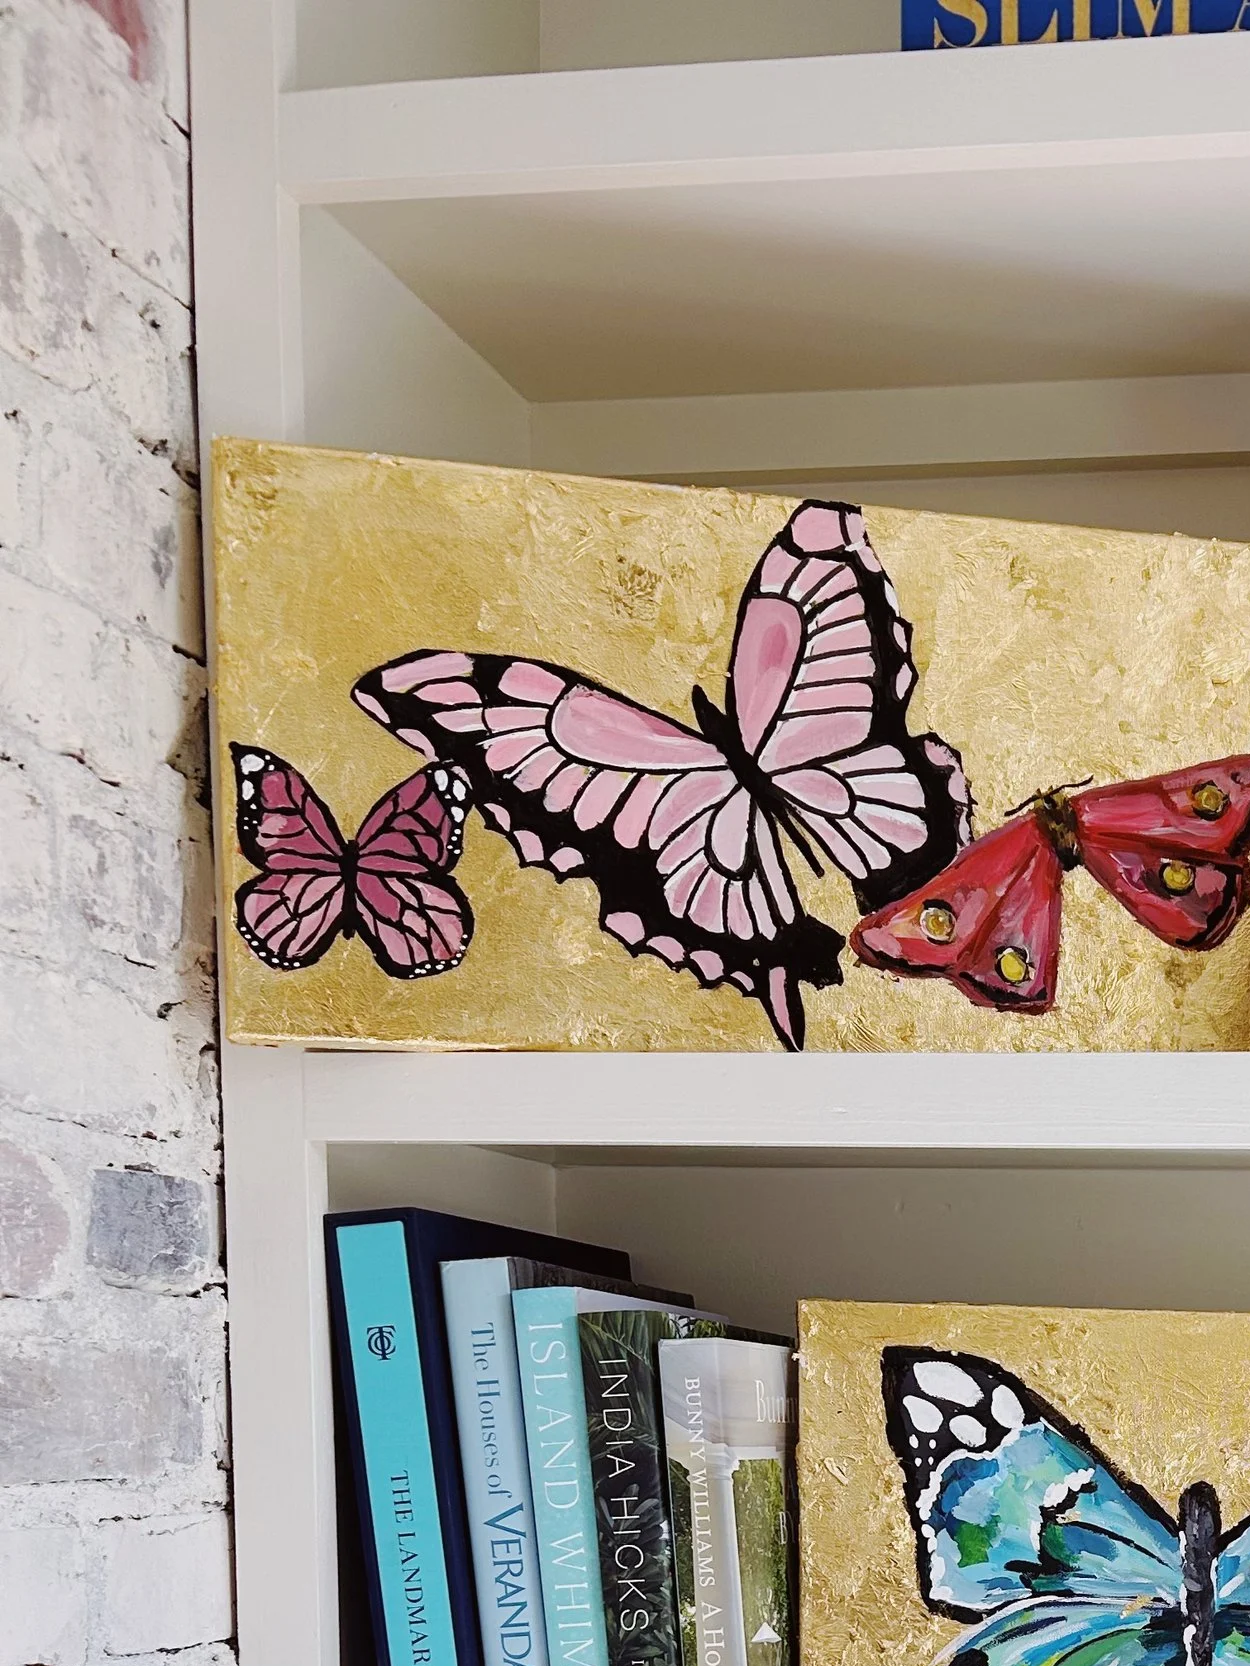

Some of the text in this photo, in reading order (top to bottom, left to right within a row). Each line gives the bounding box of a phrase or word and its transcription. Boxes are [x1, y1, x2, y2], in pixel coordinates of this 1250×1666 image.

[471, 1322, 497, 1371] The
[476, 1379, 502, 1468] Houses
[528, 1323, 581, 1509] ISLAND
[684, 1376, 707, 1462] BUNNY
[390, 1469, 416, 1524] THE
[487, 1474, 513, 1499] of
[598, 1359, 650, 1632] INDIA HICKS
[690, 1467, 716, 1588] WILLIAMS
[701, 1601, 723, 1621] A
